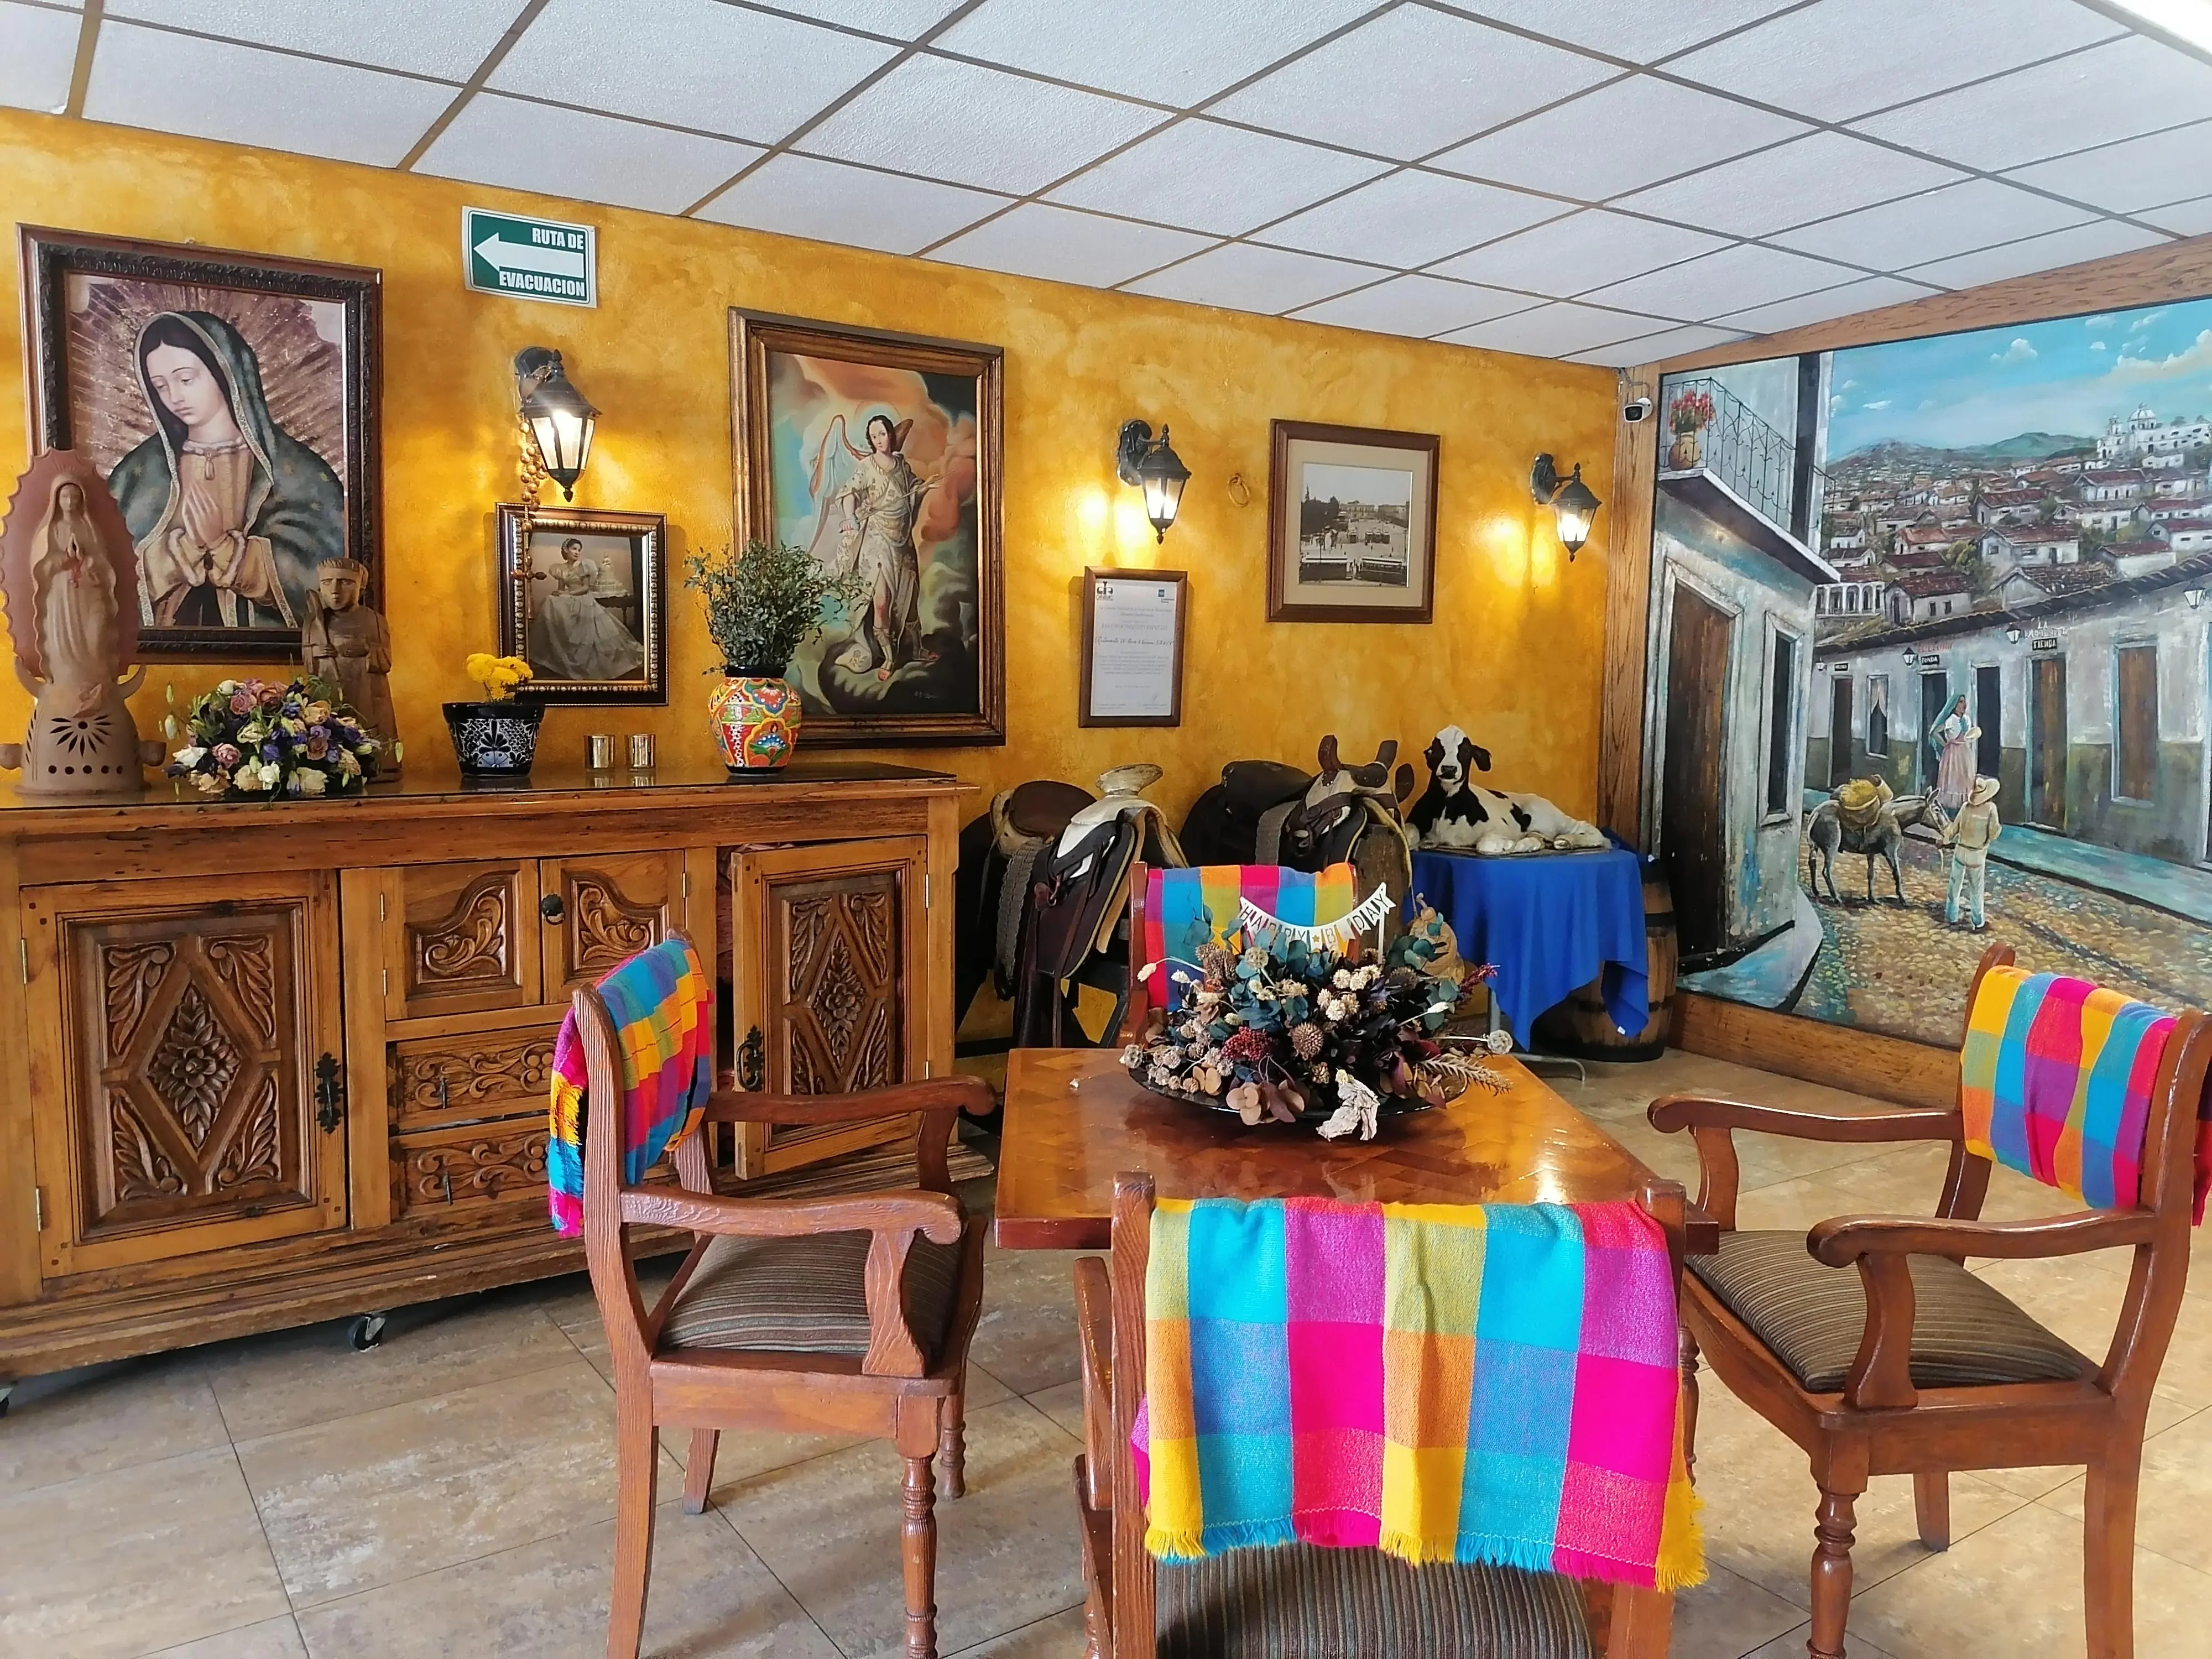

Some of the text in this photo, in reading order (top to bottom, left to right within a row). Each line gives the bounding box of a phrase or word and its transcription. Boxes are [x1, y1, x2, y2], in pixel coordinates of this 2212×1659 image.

[532, 227, 584, 250] RUTA DE
[499, 270, 586, 297] EVACUACION
[2033, 639, 2056, 649] TIENDA
[1352, 893, 1389, 930] DAY
